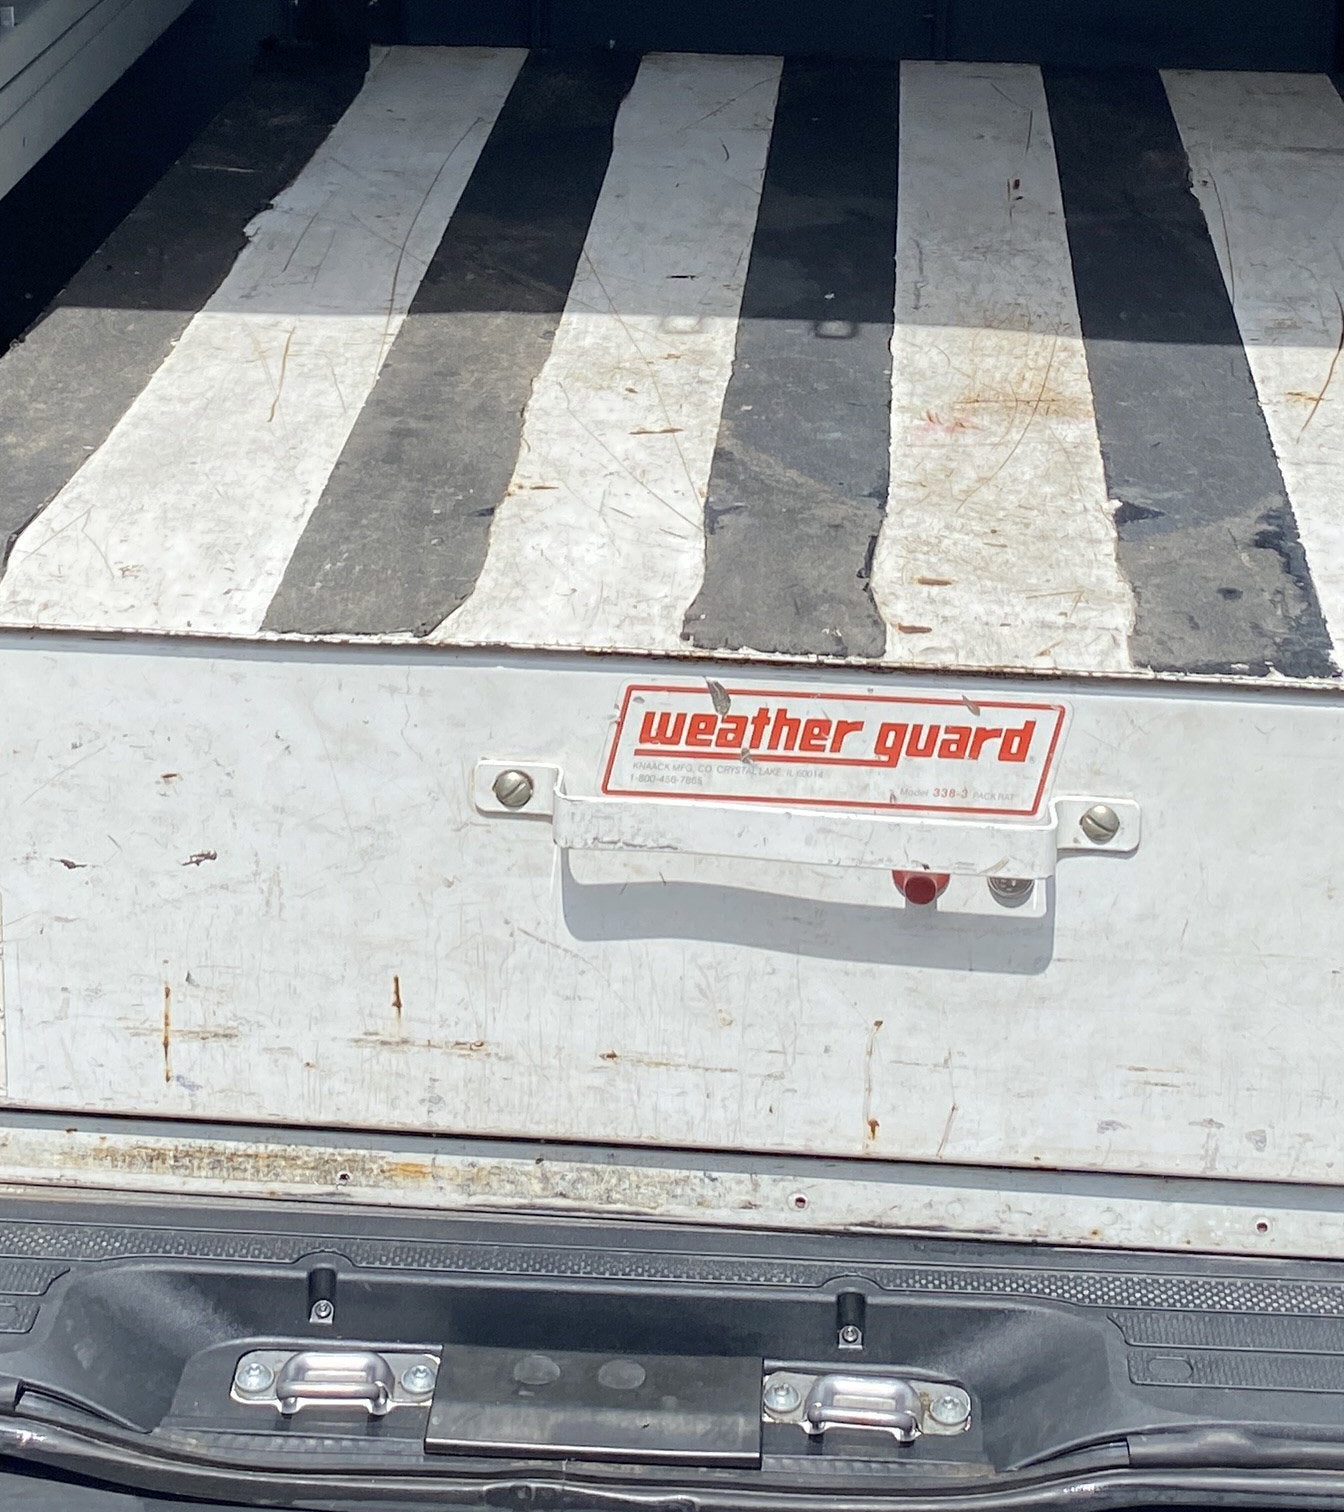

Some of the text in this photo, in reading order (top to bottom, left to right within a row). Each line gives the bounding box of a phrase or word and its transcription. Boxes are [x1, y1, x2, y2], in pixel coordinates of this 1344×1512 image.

[639, 707, 1036, 767] weather guard
[632, 761, 670, 772] KNAACK
[716, 765, 757, 776] CRYSTAL
[899, 788, 929, 797] Model
[932, 787, 968, 799] 338-3
[972, 792, 996, 800] PACK
